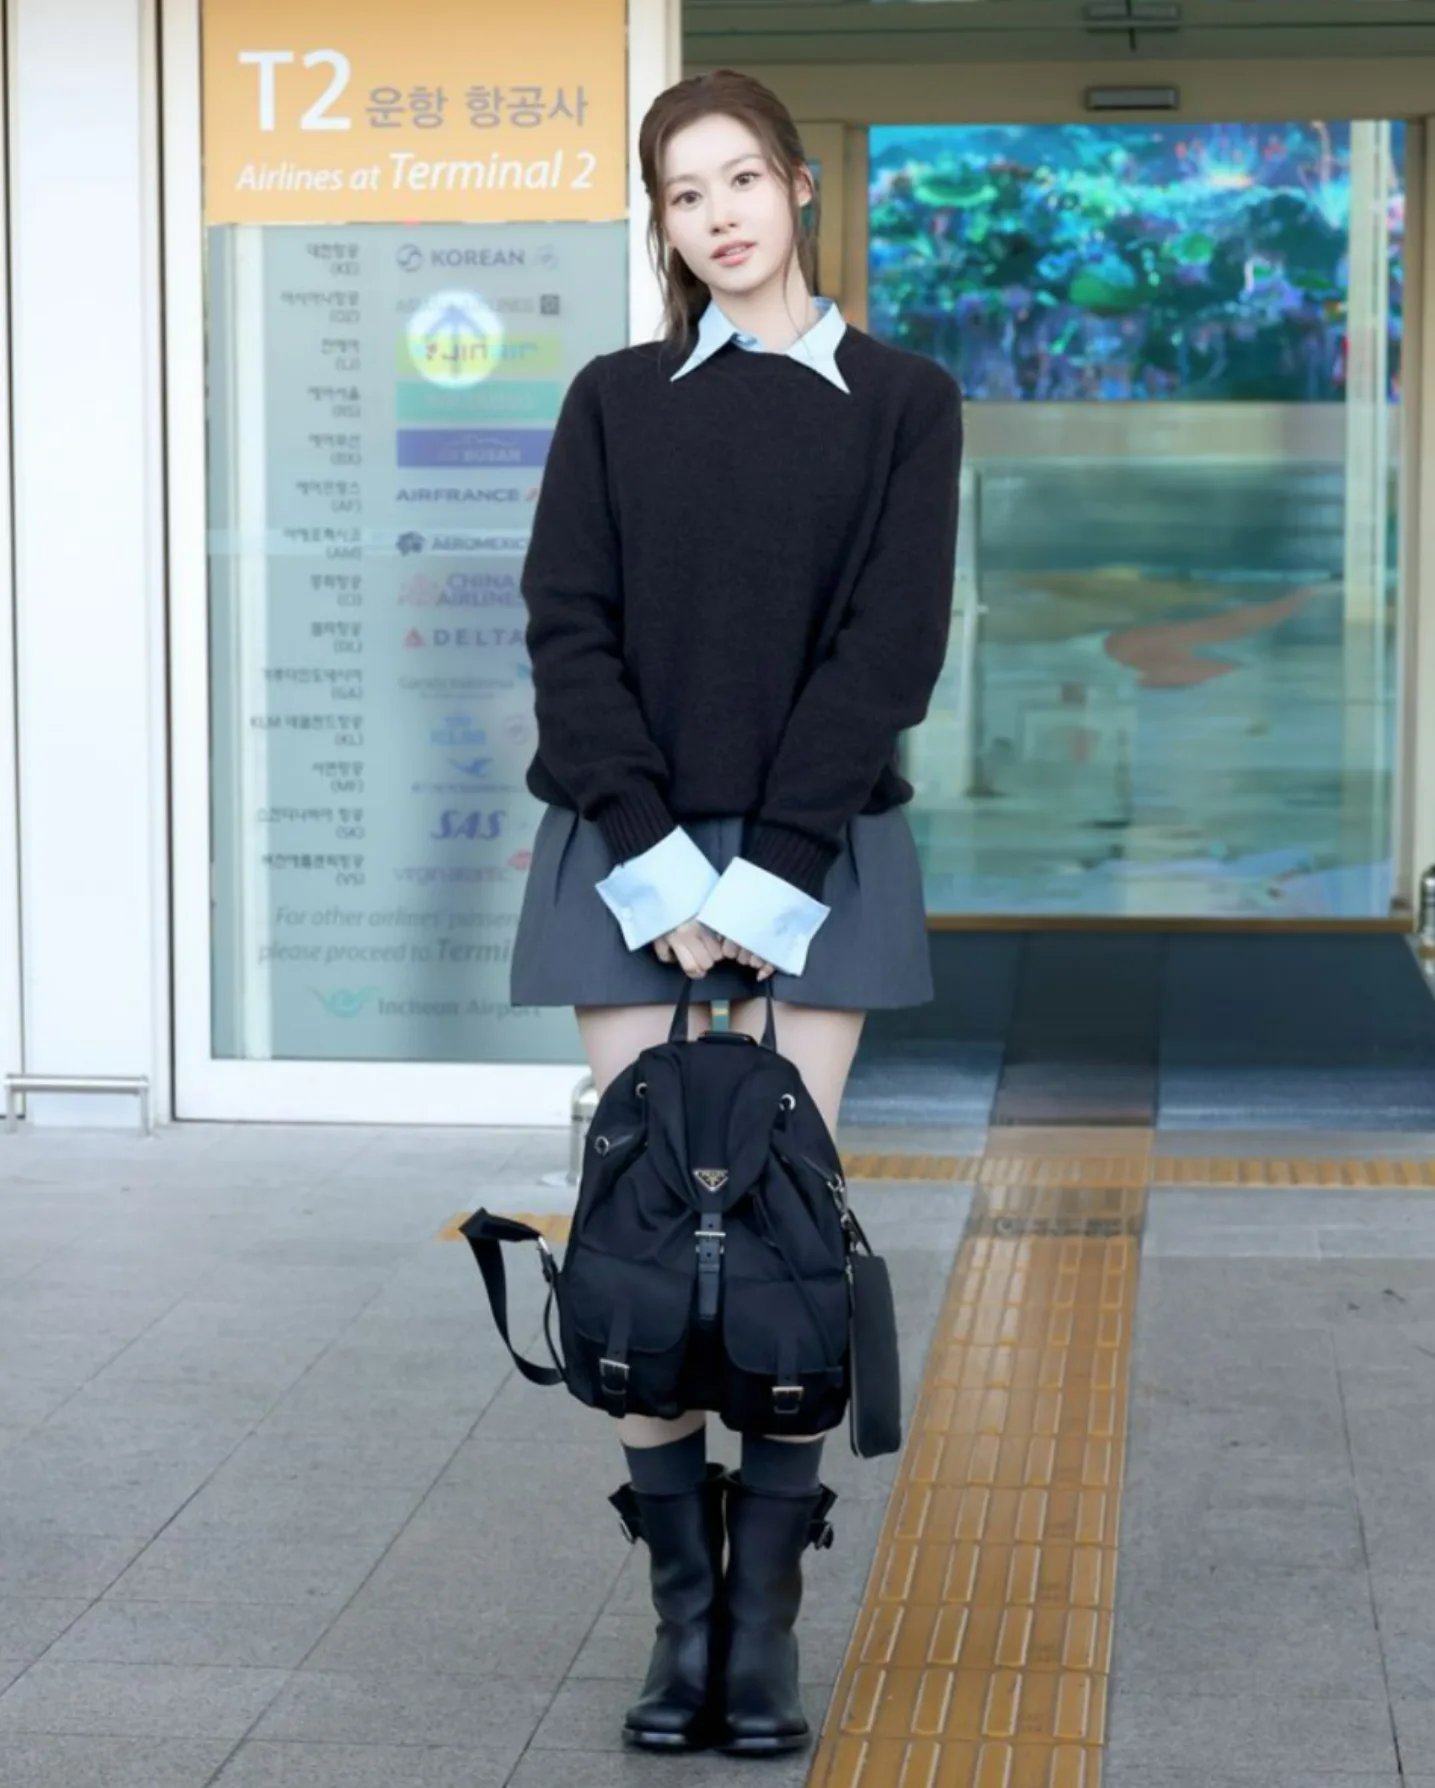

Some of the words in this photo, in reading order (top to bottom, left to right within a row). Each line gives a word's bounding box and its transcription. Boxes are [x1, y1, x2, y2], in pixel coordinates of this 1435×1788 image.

[238, 48, 352, 133] T2
[366, 85, 448, 130] 운항
[466, 84, 589, 130] 항공사
[236, 161, 343, 192] Airlines
[349, 166, 381, 191] at
[389, 148, 564, 191] Terminal
[570, 151, 597, 190] 2
[429, 247, 526, 267] KOREAN
[432, 627, 526, 647] DELTA
[430, 807, 508, 841] SAS
[275, 904, 307, 926] For
[311, 903, 364, 927] other
[257, 940, 323, 966] please
[324, 941, 408, 966] proceed
[436, 937, 511, 963] Termi
[377, 997, 460, 1017] Incheon
